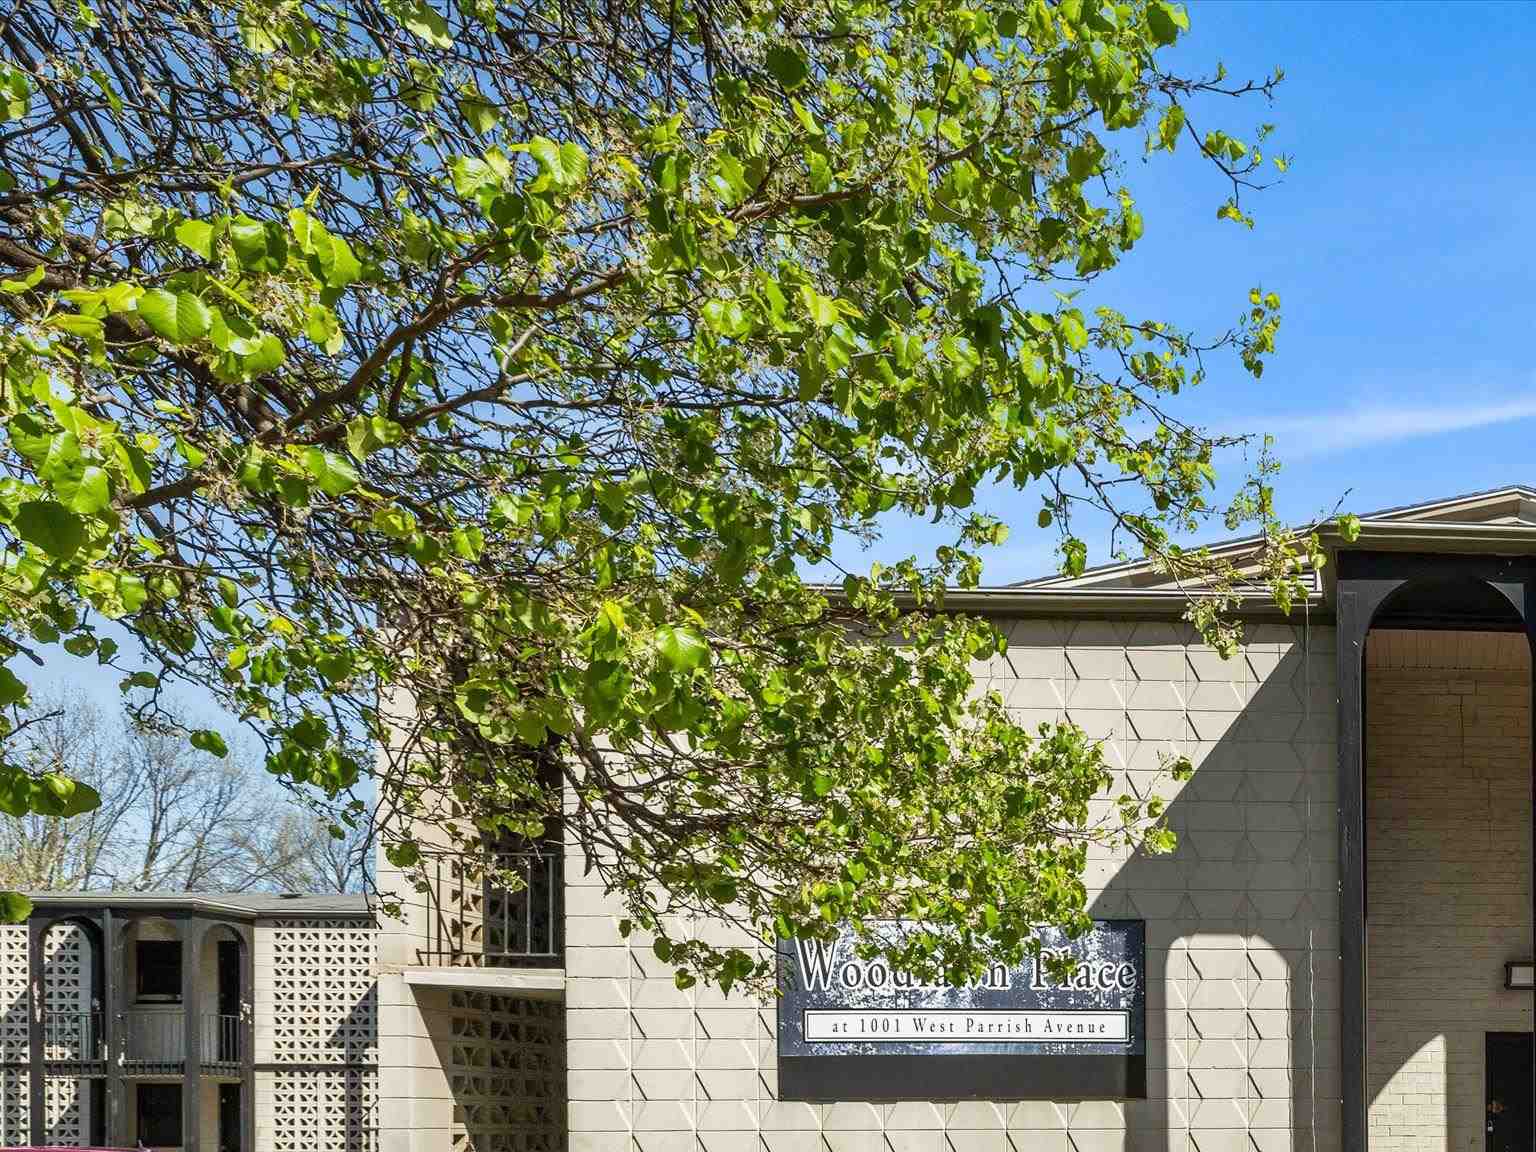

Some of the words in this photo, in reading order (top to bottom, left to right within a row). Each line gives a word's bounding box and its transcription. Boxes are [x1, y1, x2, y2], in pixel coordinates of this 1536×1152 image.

[832, 1022, 848, 1033] at
[860, 1018, 900, 1033] 1001
[913, 1018, 954, 1033] West
[966, 1018, 1032, 1033] Parrish
[1044, 1018, 1105, 1033] Avenue
